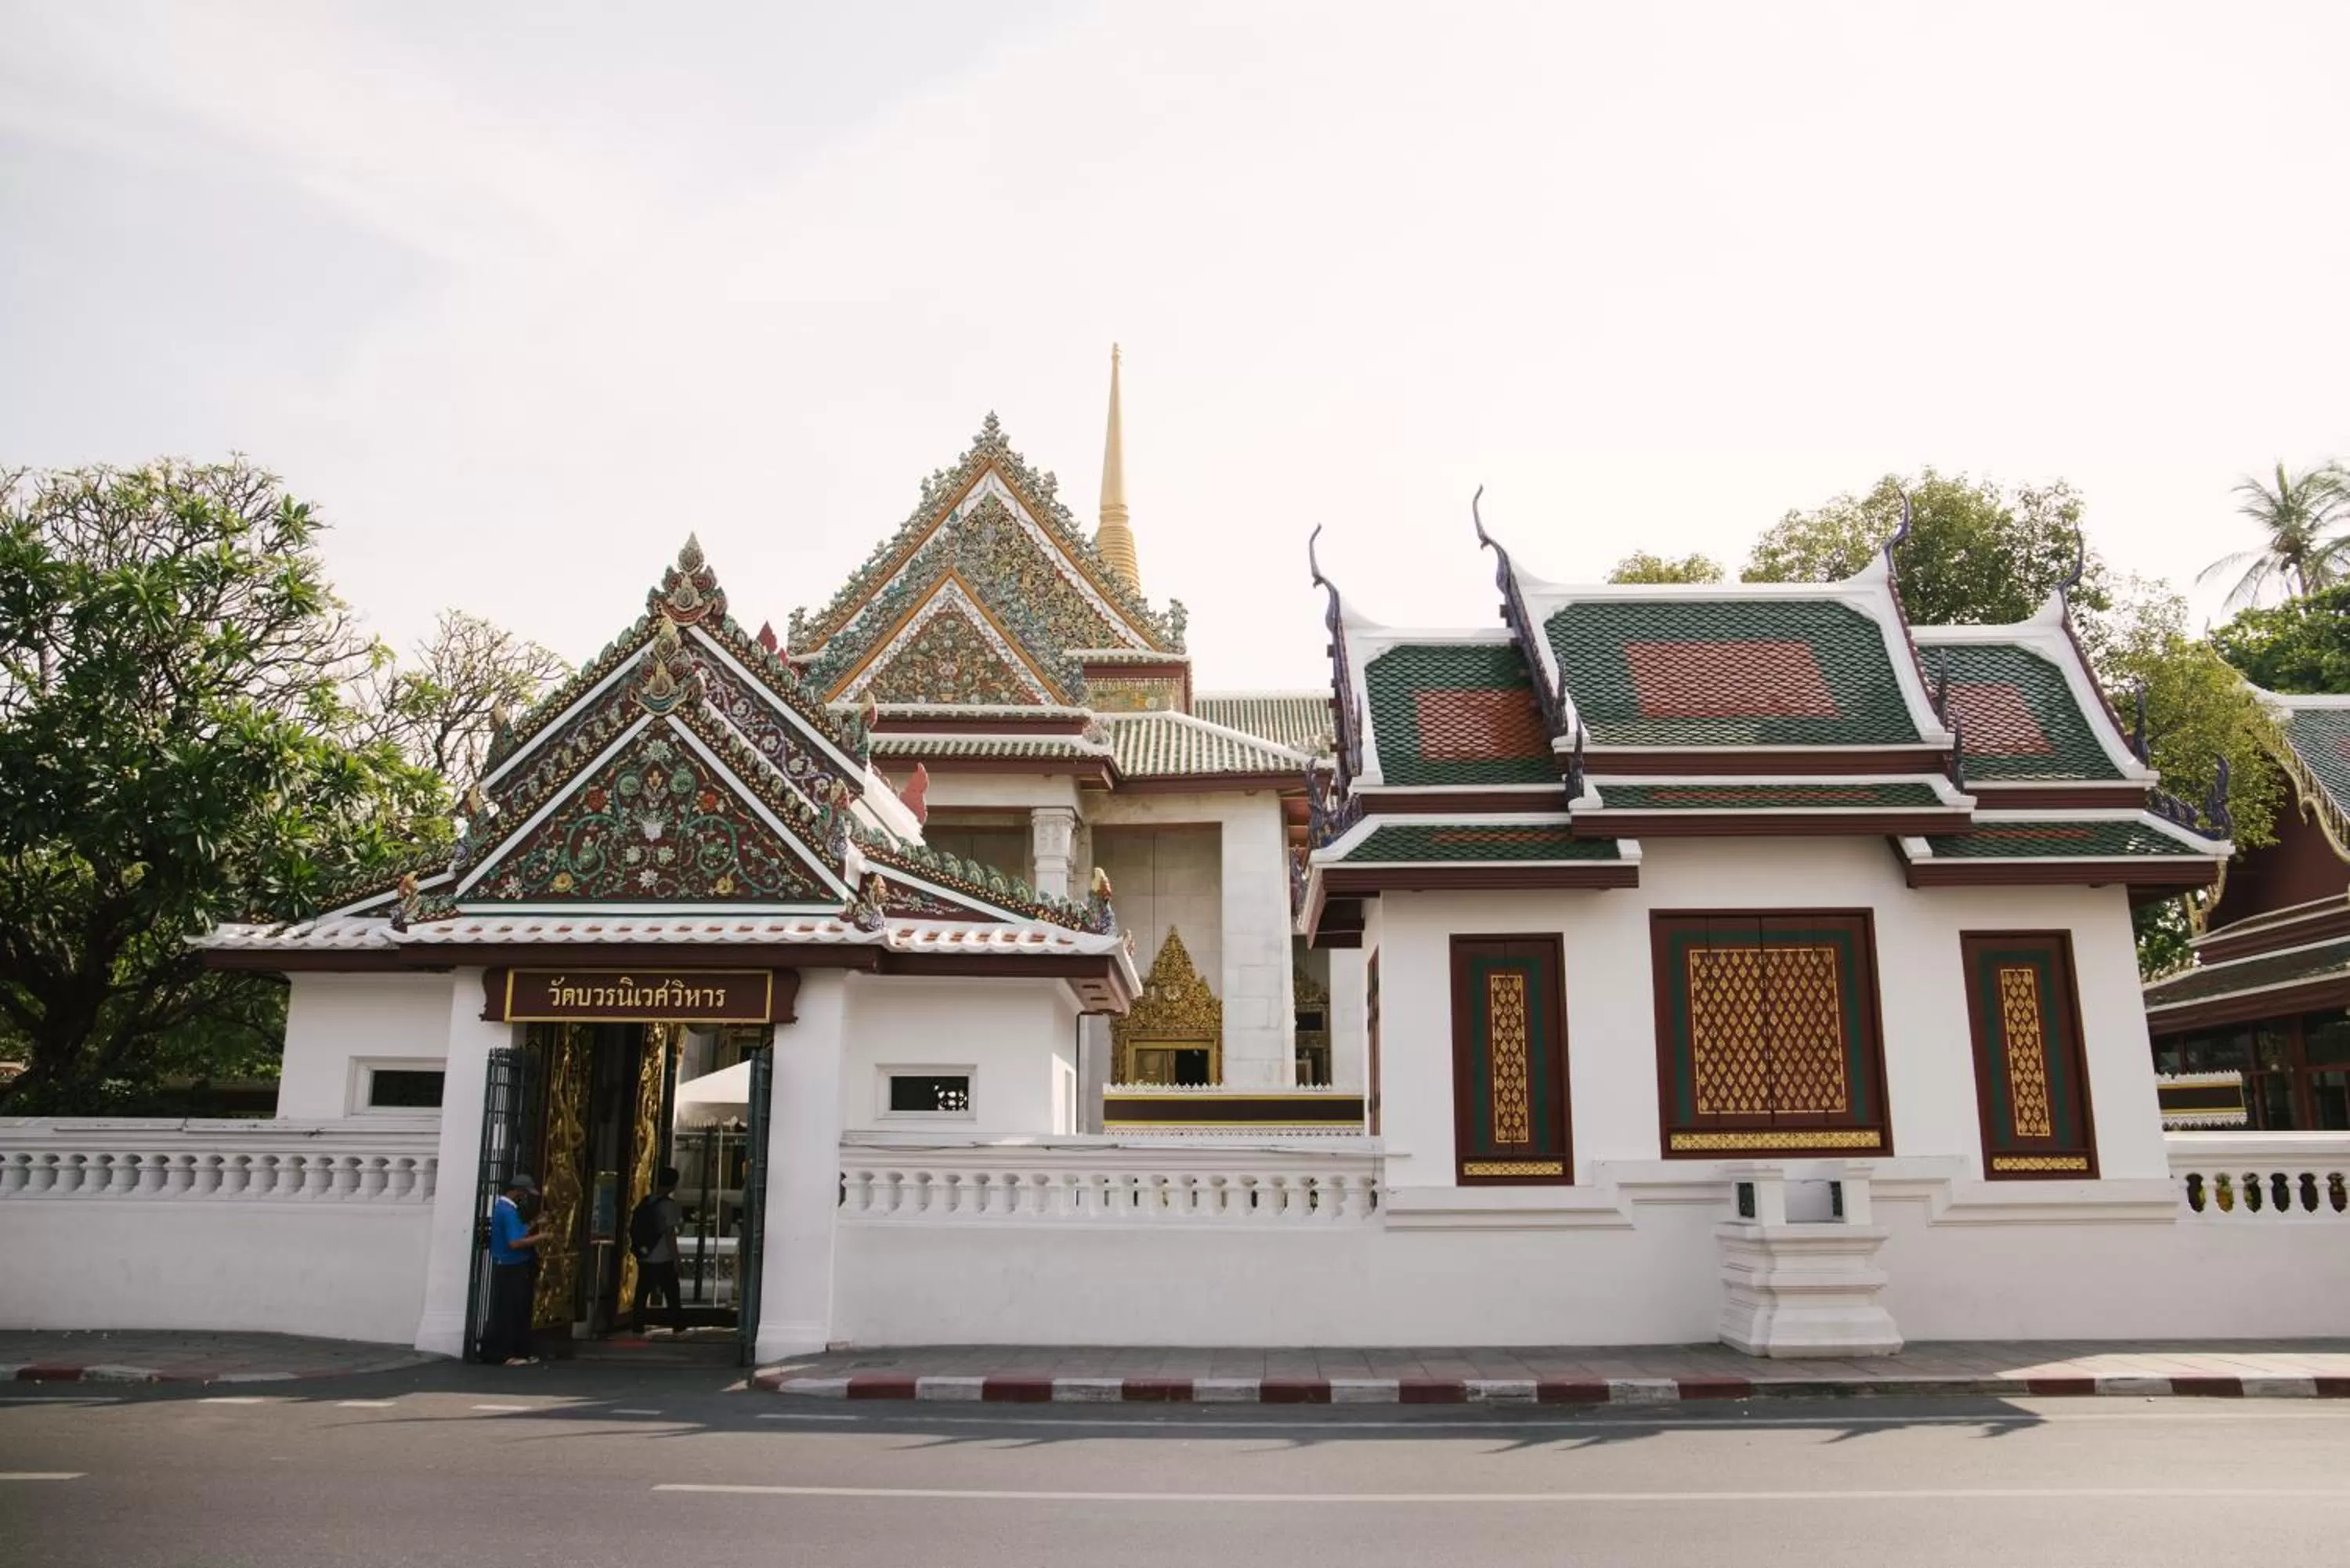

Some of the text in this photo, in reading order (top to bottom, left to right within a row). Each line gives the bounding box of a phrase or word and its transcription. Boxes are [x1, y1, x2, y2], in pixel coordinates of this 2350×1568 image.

[548, 976, 726, 1007] วัดบวรนิเวศวิหาร
